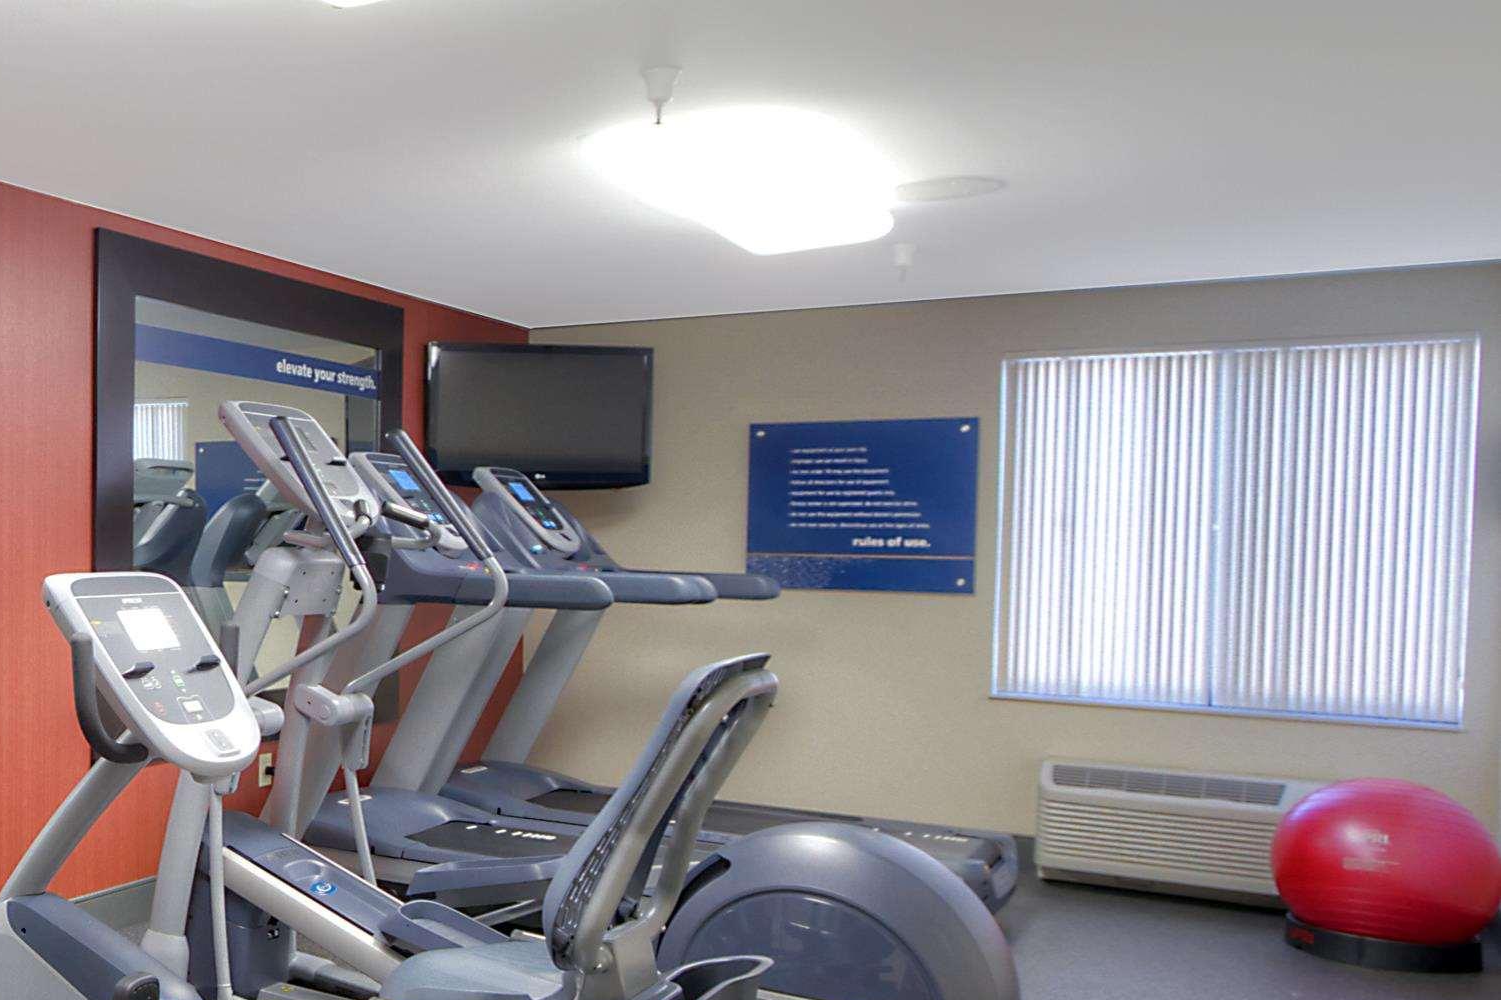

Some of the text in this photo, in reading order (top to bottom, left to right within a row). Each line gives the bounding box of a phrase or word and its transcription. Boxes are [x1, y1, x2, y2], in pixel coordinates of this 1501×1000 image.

[276, 359, 377, 391] elevate your strength.
[852, 536, 885, 548] rules
[886, 536, 903, 548] of
